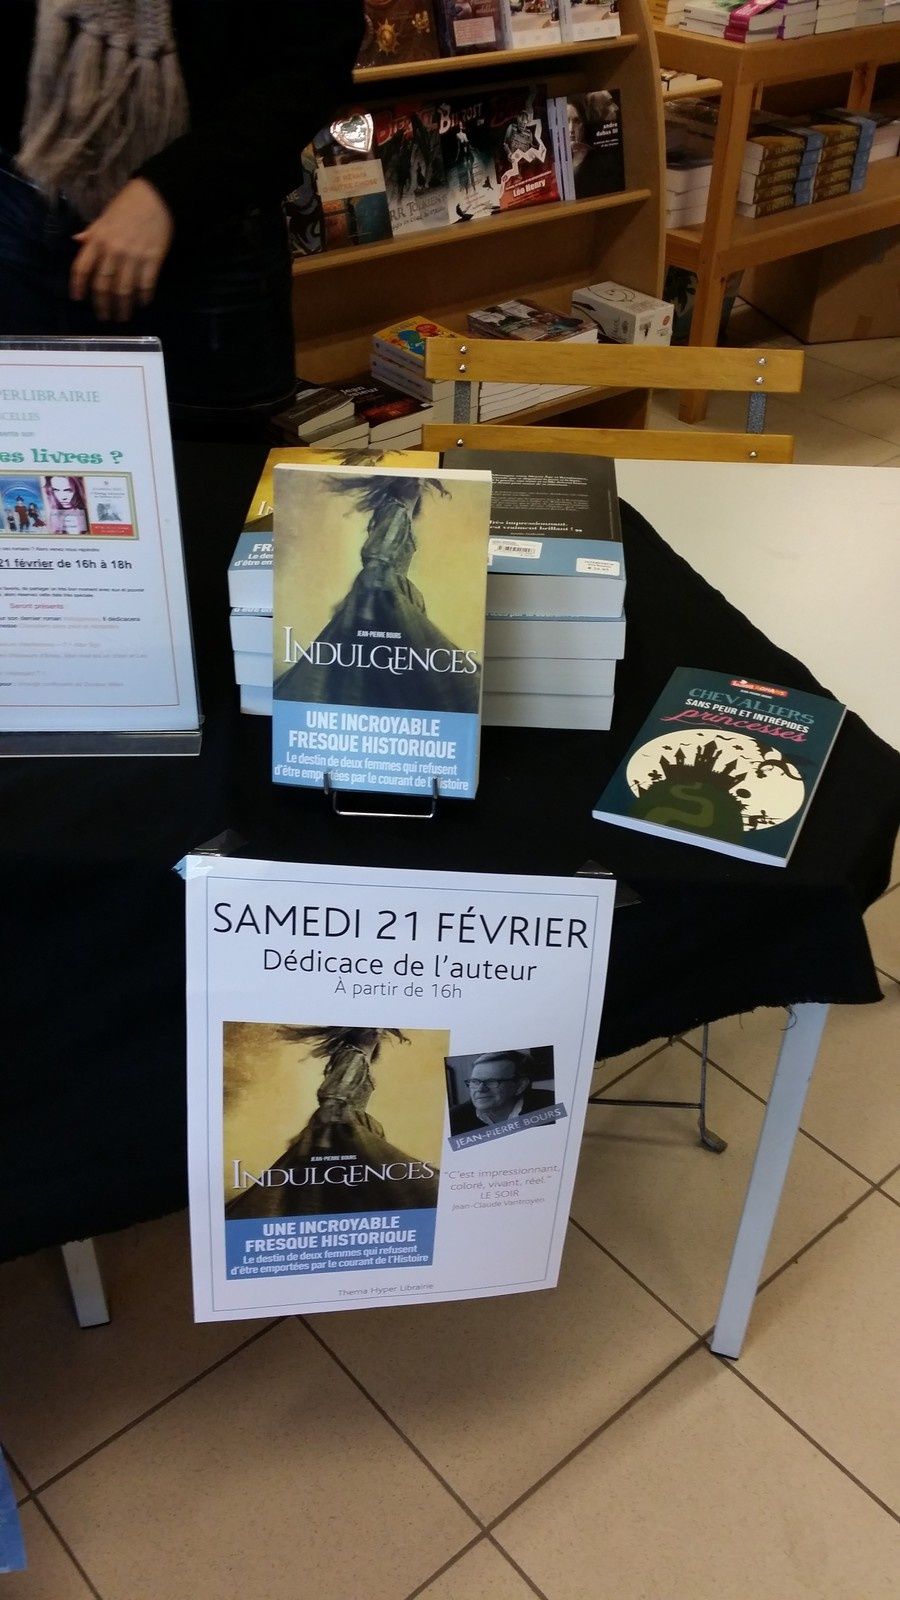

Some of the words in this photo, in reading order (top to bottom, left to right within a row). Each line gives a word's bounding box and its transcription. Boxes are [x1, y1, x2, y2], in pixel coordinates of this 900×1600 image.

[32, 448, 103, 464] livres
[110, 451, 123, 464] ?
[253, 544, 273, 552] FR
[15, 557, 53, 568] février
[57, 559, 72, 569] de
[75, 559, 97, 569] 16h
[100, 560, 108, 569] à
[111, 560, 133, 570] 18h
[282, 626, 478, 675] INDULGENCES
[685, 698, 711, 709] SANS
[712, 703, 738, 716] PEUR
[738, 709, 753, 719] ET
[752, 712, 810, 734] INTRÉPIDES
[688, 687, 815, 725] CHEVALIERS
[306, 711, 339, 730] UNE
[341, 713, 440, 737] INCROYABLE
[659, 708, 807, 743] princesses
[288, 730, 359, 752] FRESQUE
[362, 737, 456, 760] HISTORIQUE
[274, 765, 300, 778] d'être
[351, 773, 365, 785] par
[367, 771, 377, 784] le
[378, 774, 413, 787] courant
[414, 774, 426, 787] de
[286, 752, 297, 763] Le
[298, 753, 326, 766] destin
[327, 755, 339, 767] de
[341, 756, 363, 769] deux
[364, 758, 402, 772] femmes
[402, 761, 417, 775] qui
[419, 762, 458, 776] refusent
[213, 902, 361, 939] SAMEDI
[376, 910, 419, 942] 21
[437, 905, 589, 949] FÉVRIER
[263, 948, 384, 976] Dédicace
[393, 953, 424, 978] de
[435, 955, 538, 982] l'auteur
[334, 975, 347, 995] À
[352, 980, 399, 1000] partir
[404, 981, 424, 998] de
[431, 982, 463, 999] 16h
[455, 1121, 521, 1148] JEAN-PIERRE
[524, 1108, 562, 1126] BOURS
[232, 1159, 435, 1189] INDULGENCES
[480, 1192, 490, 1200] LE
[494, 1189, 519, 1199] SOIR
[263, 1222, 296, 1237] UNE
[299, 1216, 400, 1235] INCROYABLE
[245, 1236, 318, 1253] FRESQUE
[321, 1230, 417, 1249] HISTORIQUE
[230, 1264, 259, 1276] d'être
[260, 1261, 310, 1275] emportées
[311, 1260, 326, 1273] par
[328, 1258, 337, 1269] le
[338, 1257, 374, 1269] courant
[375, 1255, 387, 1265] de
[387, 1252, 430, 1264] l'Histoire
[243, 1255, 254, 1265] Le
[256, 1253, 285, 1264] destin
[287, 1252, 298, 1262] de
[300, 1250, 322, 1261] deux
[324, 1247, 361, 1259] femmes
[363, 1246, 378, 1258] qui
[380, 1244, 418, 1255] refusent
[338, 1288, 368, 1297] Thema
[370, 1286, 398, 1296] Hyper
[400, 1283, 434, 1292] Librairie
